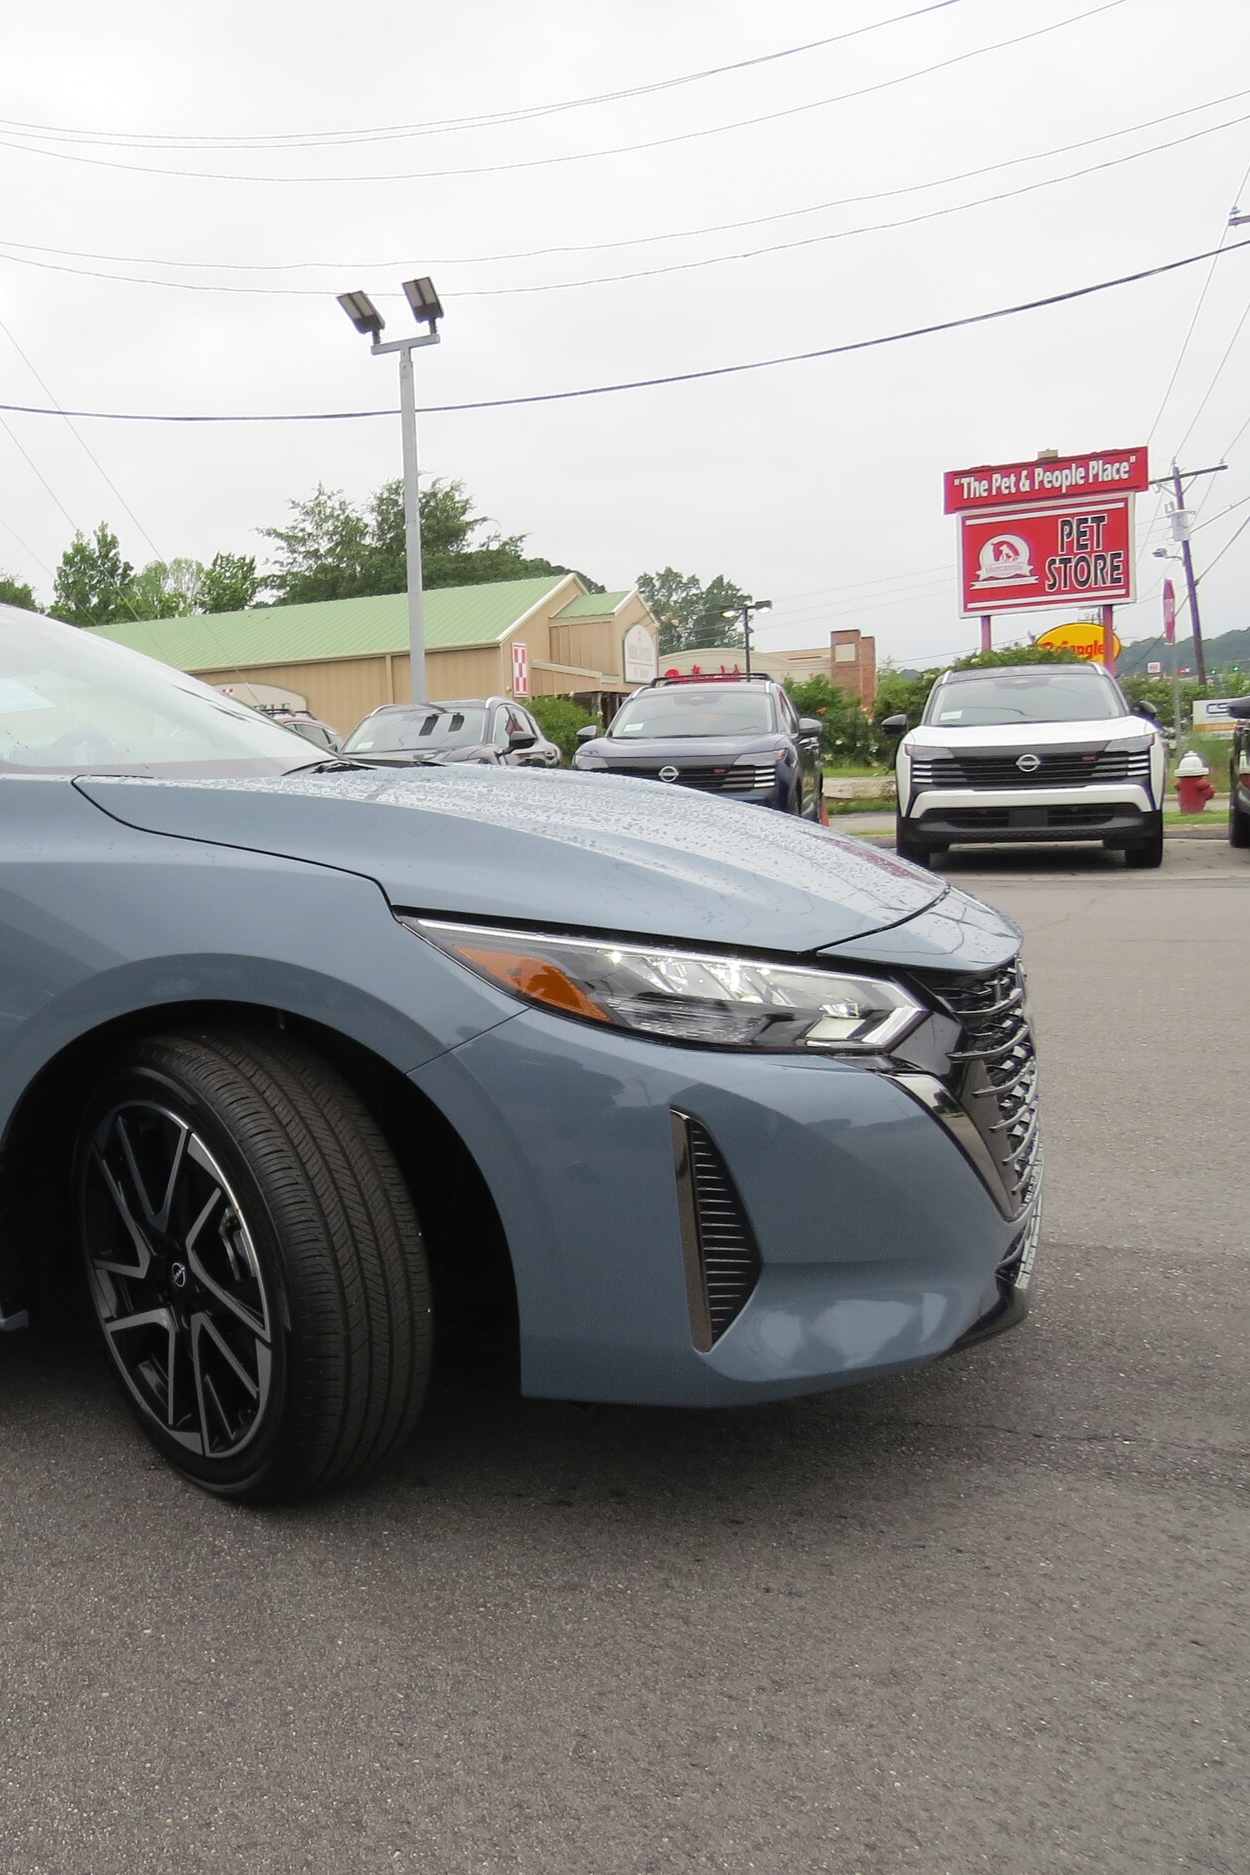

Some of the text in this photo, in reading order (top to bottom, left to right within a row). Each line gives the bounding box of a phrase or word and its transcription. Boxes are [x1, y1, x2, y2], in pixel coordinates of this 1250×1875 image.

[954, 455, 1137, 499] "The Pet & People Place"
[1059, 514, 1107, 554] PET
[1046, 551, 1124, 592] STORE
